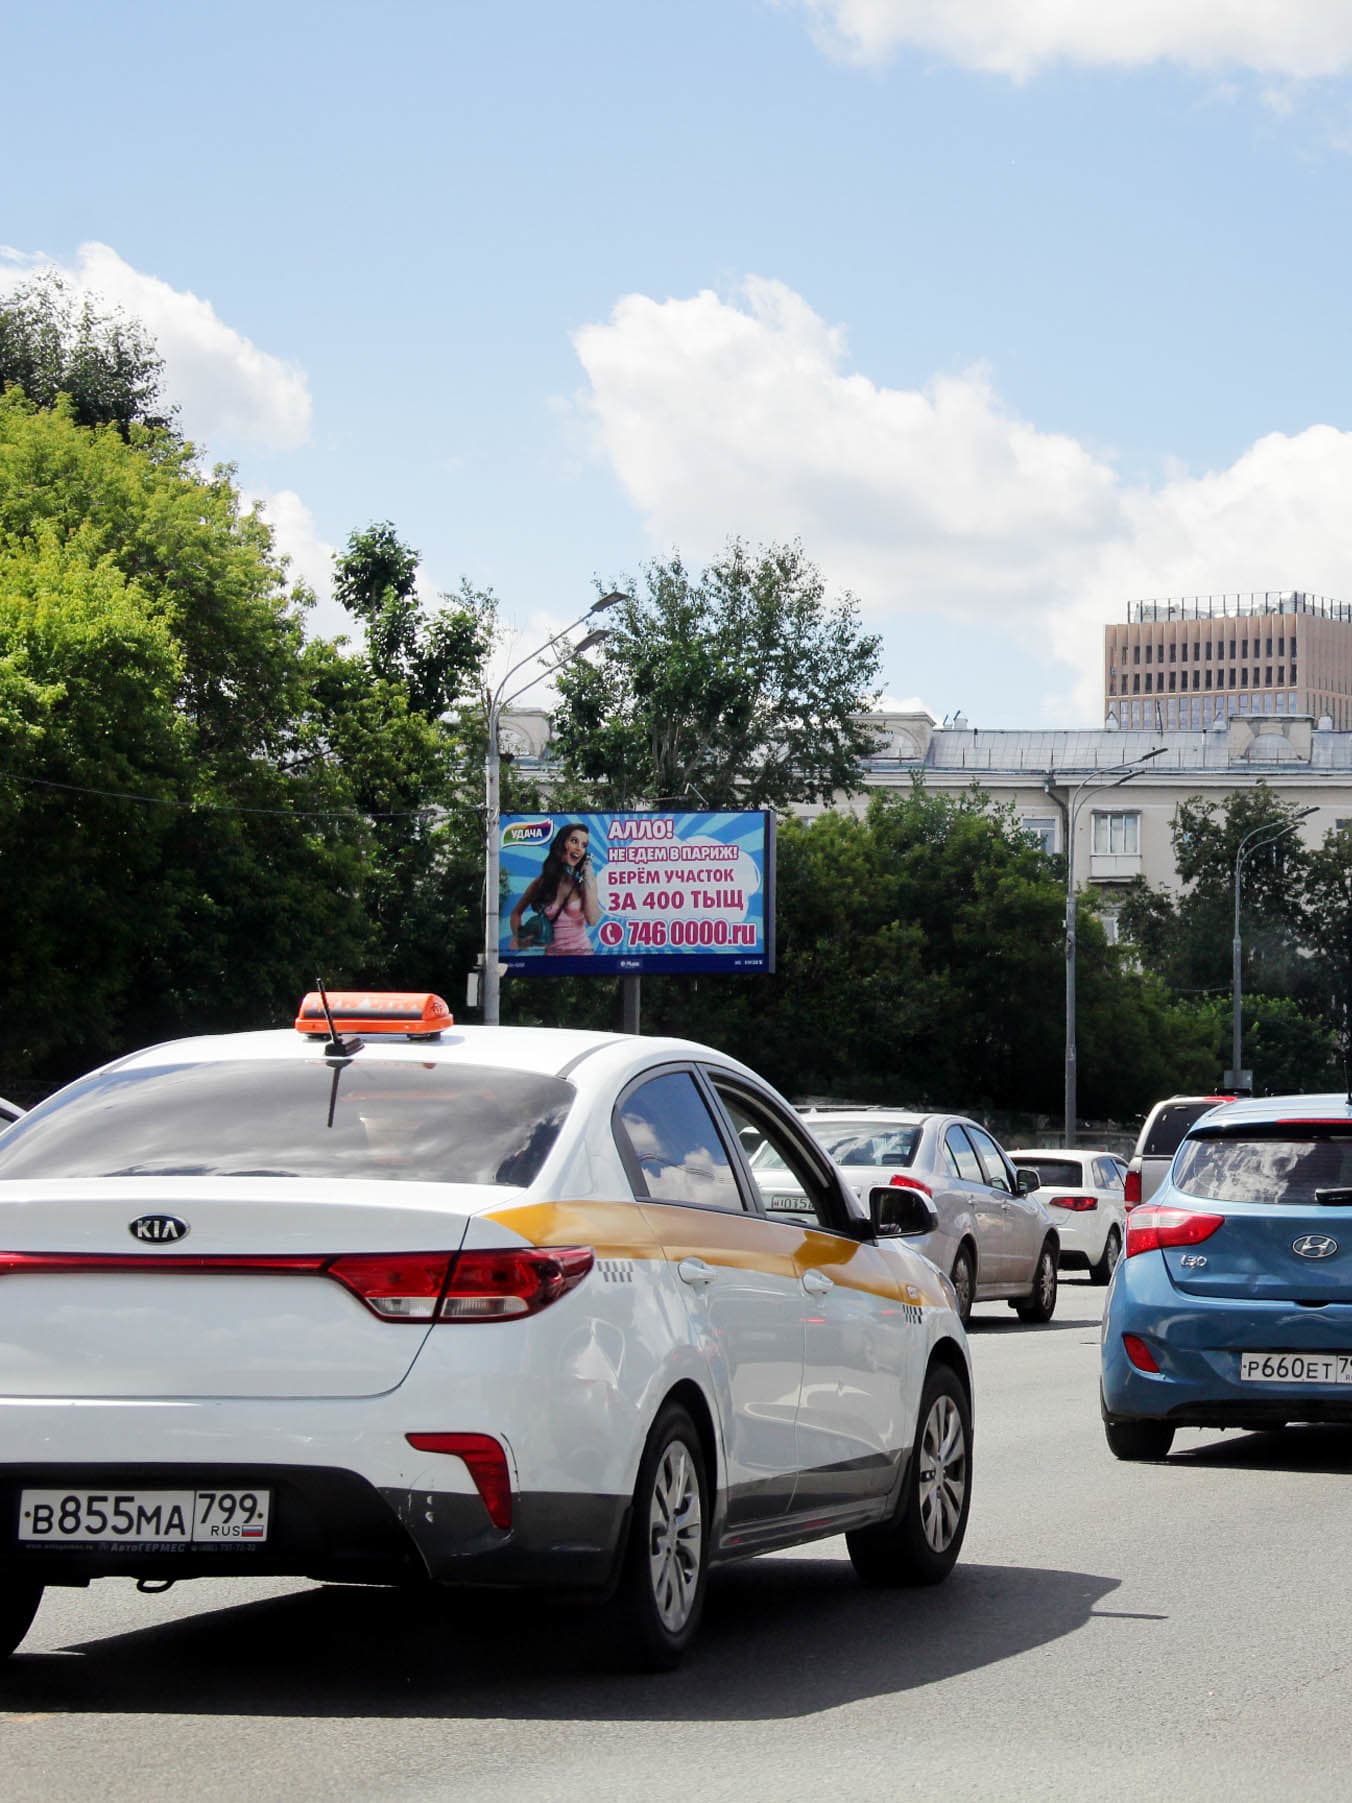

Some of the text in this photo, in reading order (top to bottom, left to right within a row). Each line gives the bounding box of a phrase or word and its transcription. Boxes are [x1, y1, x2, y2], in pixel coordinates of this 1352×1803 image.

[511, 828, 543, 840] УДАЧА
[608, 819, 674, 840] АЛЛО!
[608, 845, 739, 864] НЕ ЕДЕМ В ПАРИЖ!
[608, 868, 735, 885] БЕРЁМ УЧАСТОК
[608, 889, 744, 911] ЗА 400 ТЫЩ
[628, 920, 756, 946] 746 0000.ru
[137, 1220, 179, 1238] KIA
[198, 1493, 259, 1524] 799
[210, 1525, 241, 1536] RUS
[110, 1543, 186, 1552] АвтоГЕРМЕС
